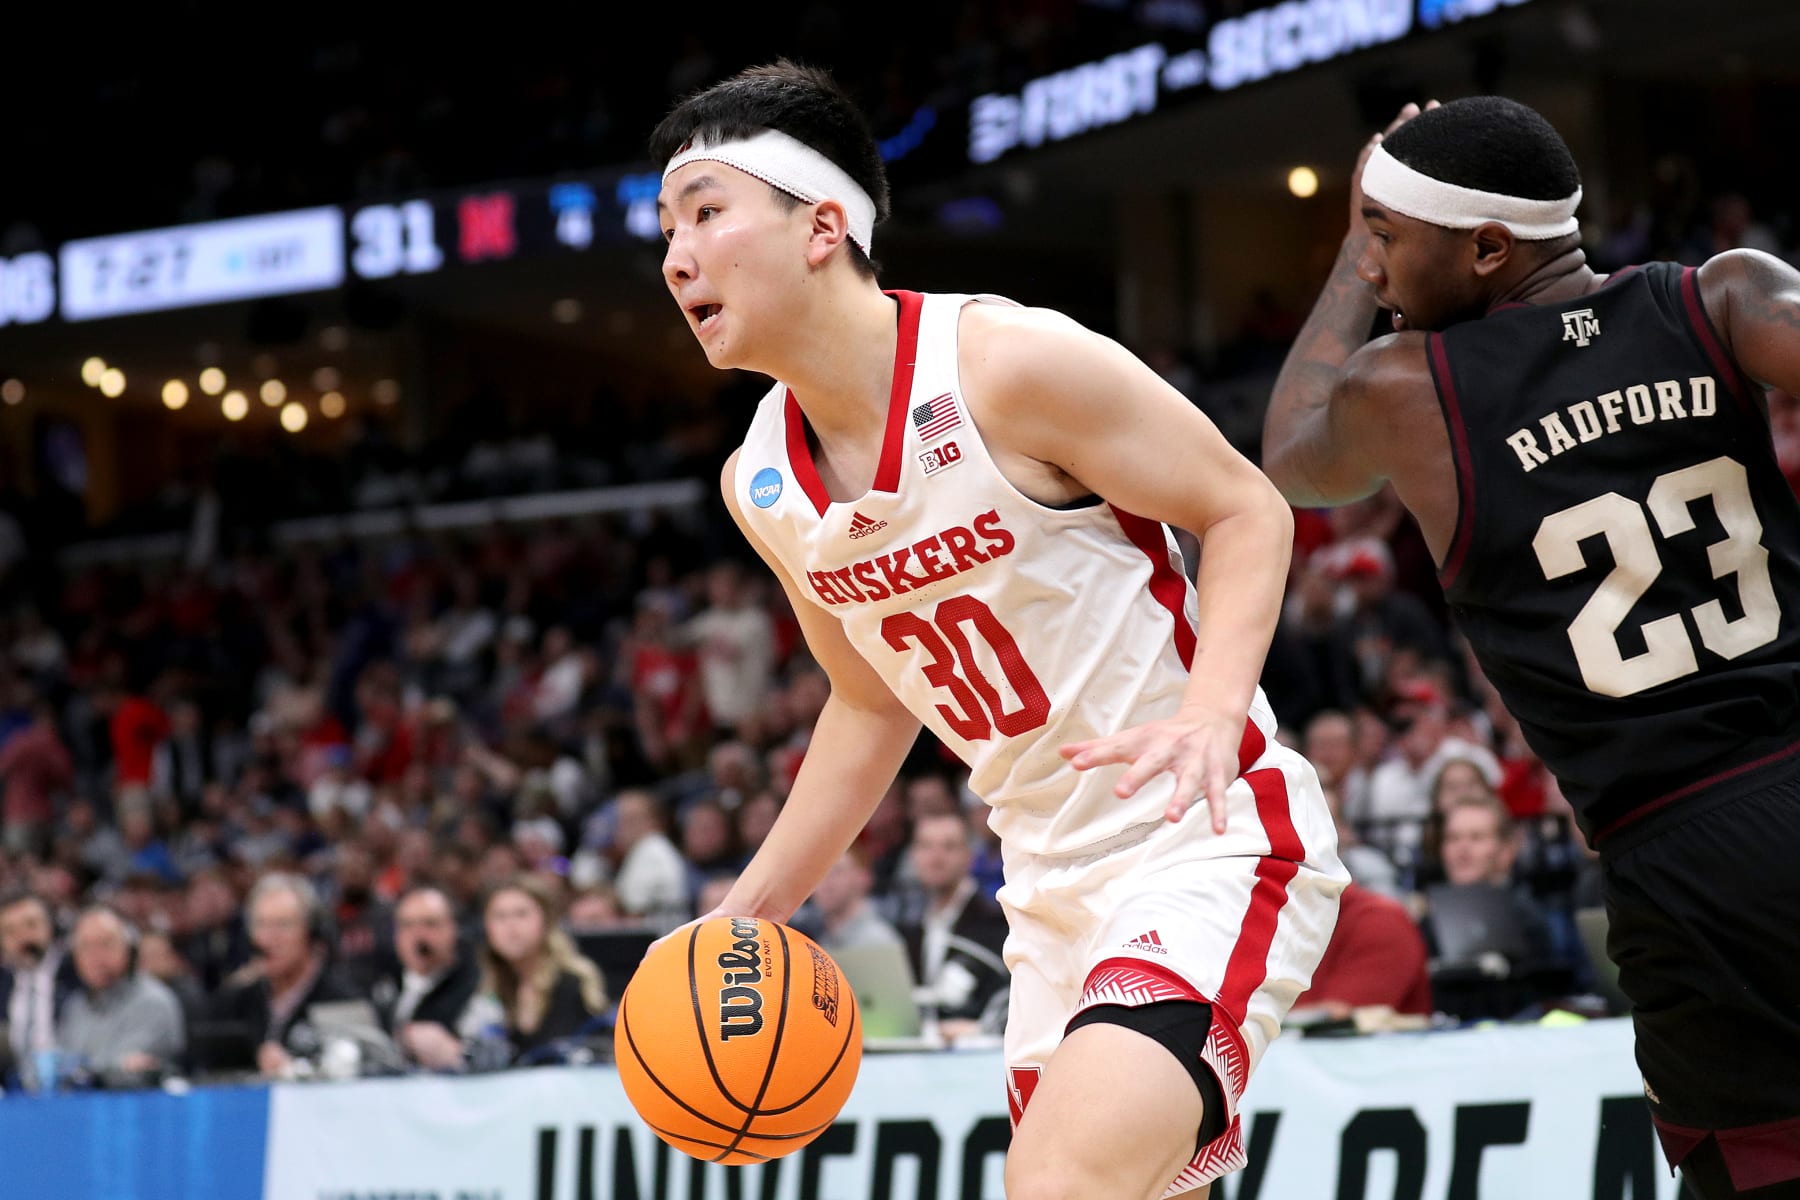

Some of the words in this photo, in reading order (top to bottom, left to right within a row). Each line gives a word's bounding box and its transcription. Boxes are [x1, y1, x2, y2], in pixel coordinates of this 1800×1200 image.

[351, 200, 444, 280] 31
[1506, 375, 1717, 473] RADFORD
[753, 482, 781, 499] NCAA
[848, 518, 888, 540] adidas
[806, 509, 1016, 605] HUSKERS
[1532, 455, 1782, 698] 23
[880, 594, 1052, 742] 30
[718, 917, 764, 1042] Wilson
[763, 939, 771, 956] NXT
[765, 957, 773, 978] EVO
